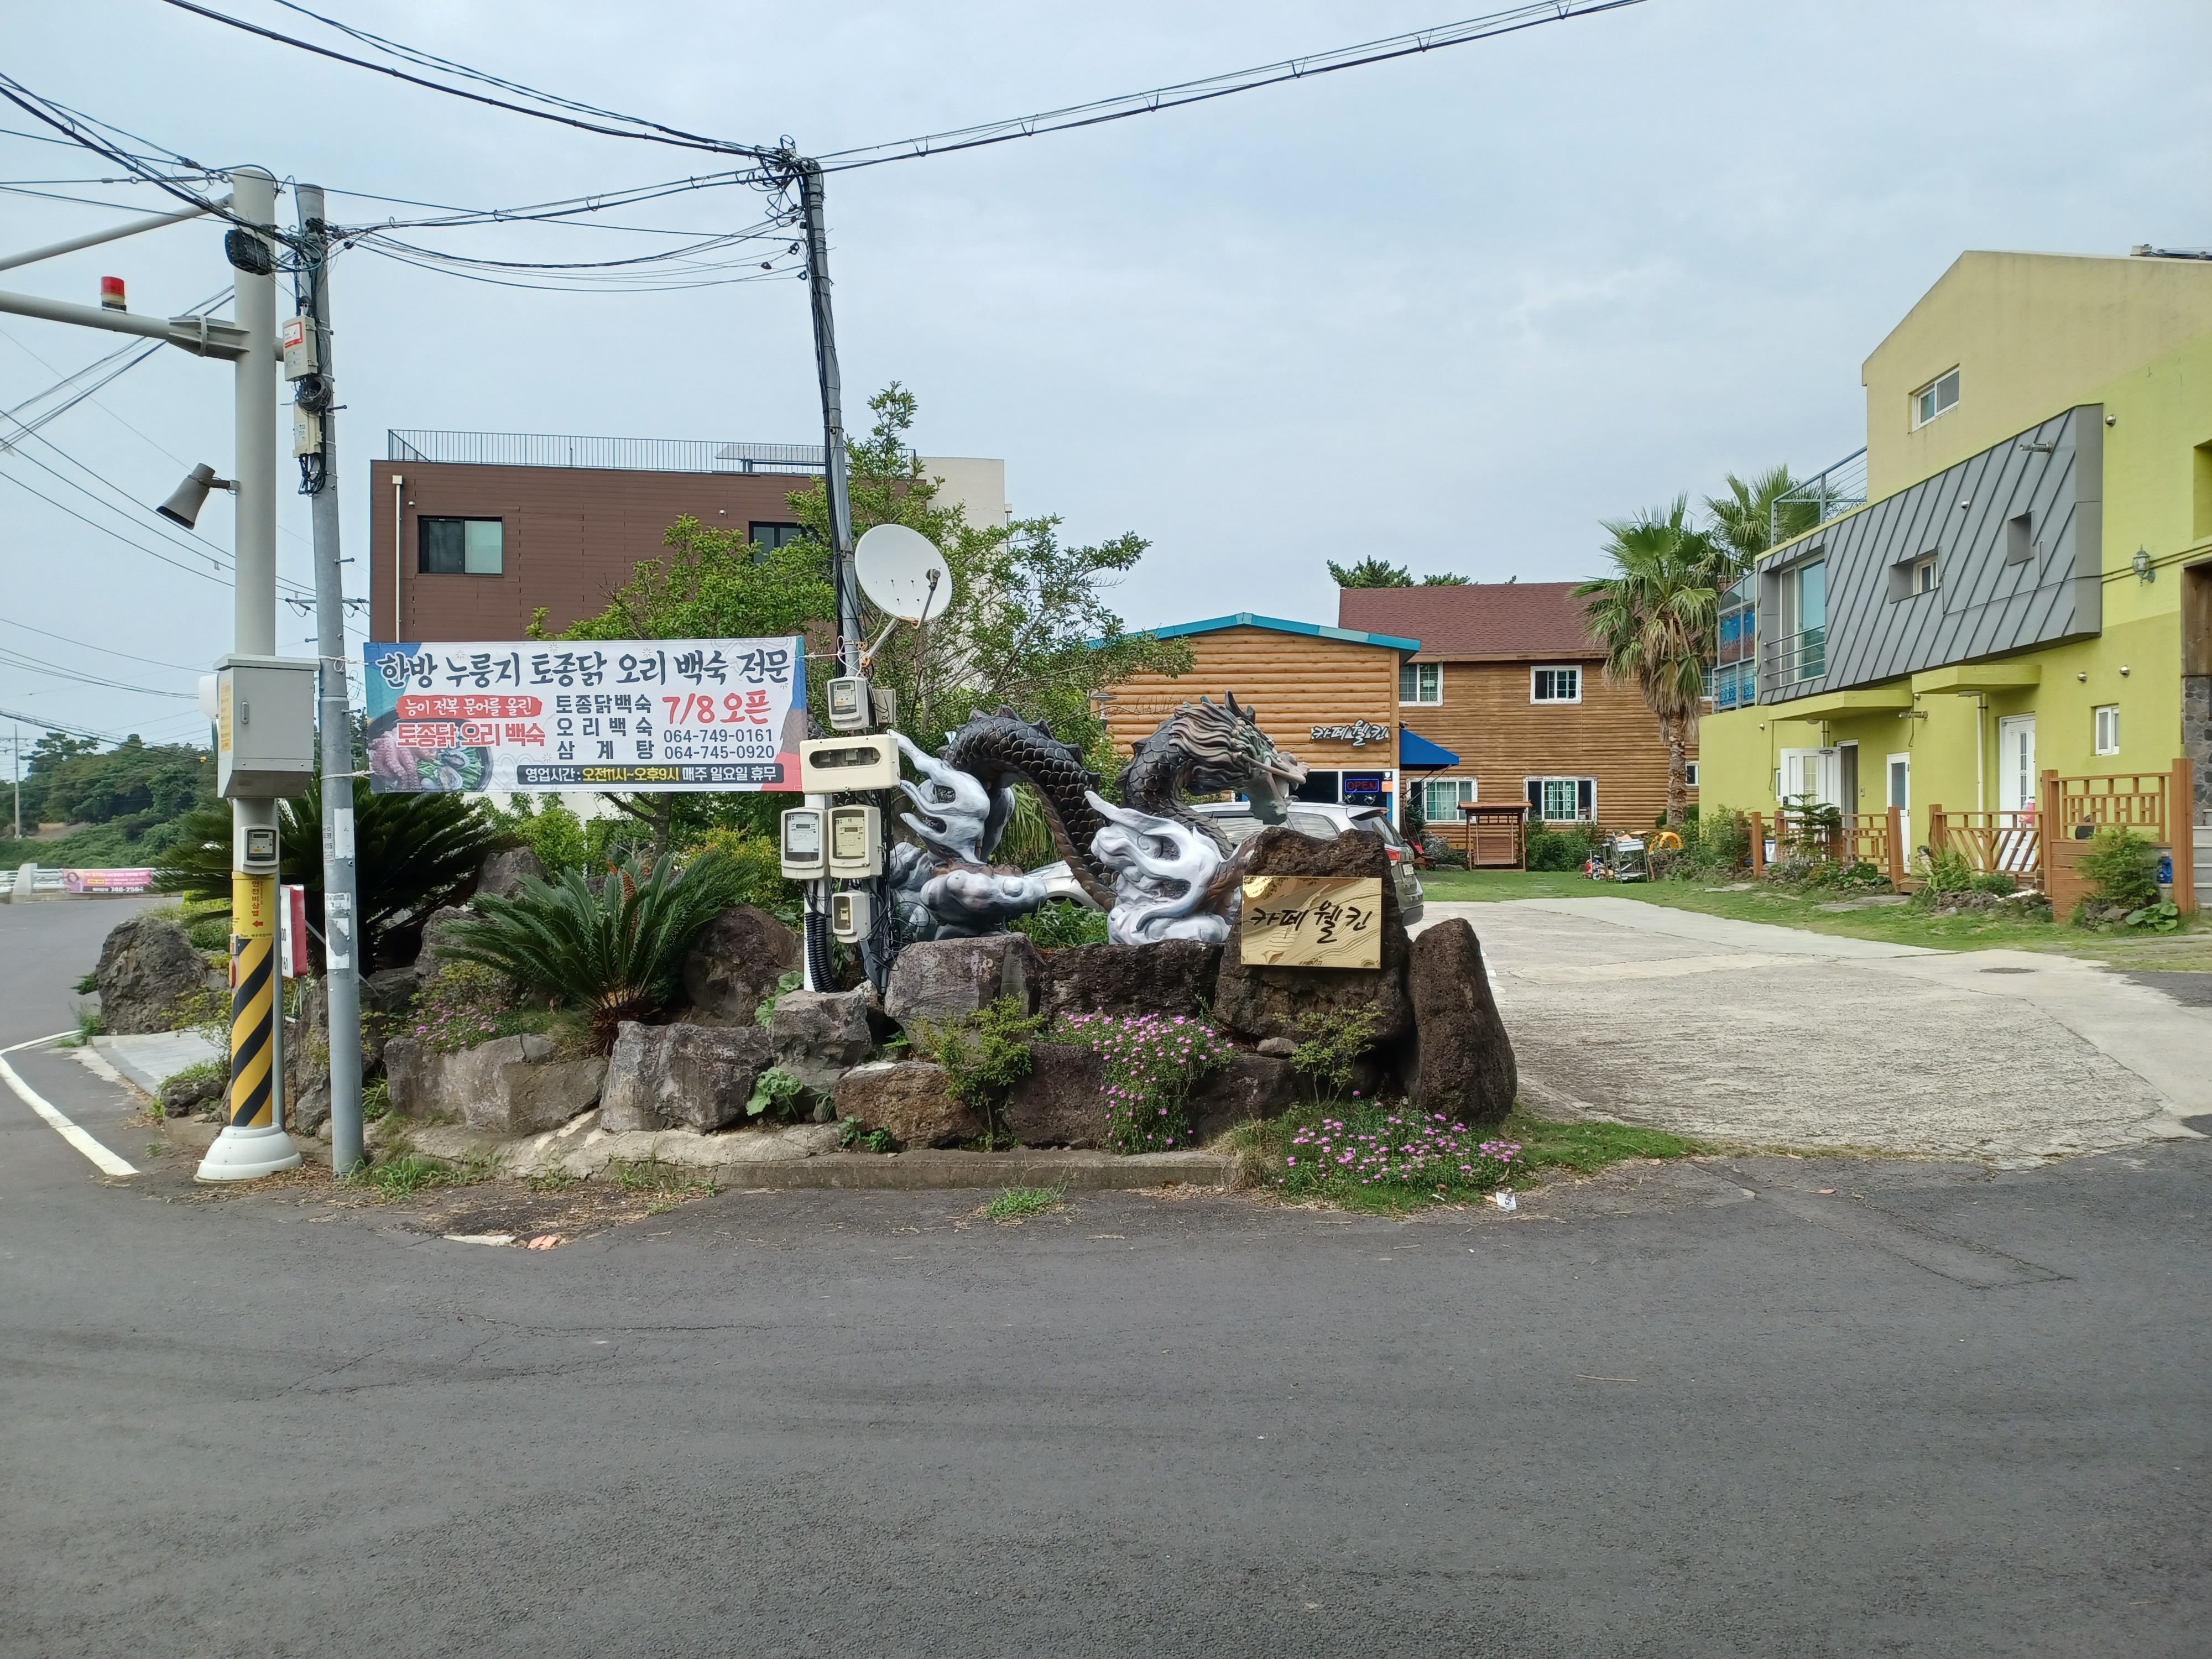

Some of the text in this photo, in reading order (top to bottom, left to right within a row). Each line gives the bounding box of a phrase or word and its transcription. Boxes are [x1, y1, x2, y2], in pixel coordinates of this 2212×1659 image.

[377, 649, 790, 688] 한방 누룽지 토종닭 오리 백숙 전문
[404, 697, 532, 716] 능이 전복 문어를 올린
[556, 695, 651, 714] 토종닭백숙
[662, 690, 771, 724] 7/8 오픈
[397, 723, 545, 747] 토종닭 오리 백숙
[664, 729, 773, 743] 064-749-0161
[1312, 725, 1350, 740] 카페
[664, 745, 775, 759] 064-745-0920
[682, 767, 707, 781] 매주
[711, 766, 748, 781] 일요일
[751, 766, 776, 781] 휴무
[1347, 781, 1377, 790] OPEN
[1250, 907, 1309, 931] 카페
